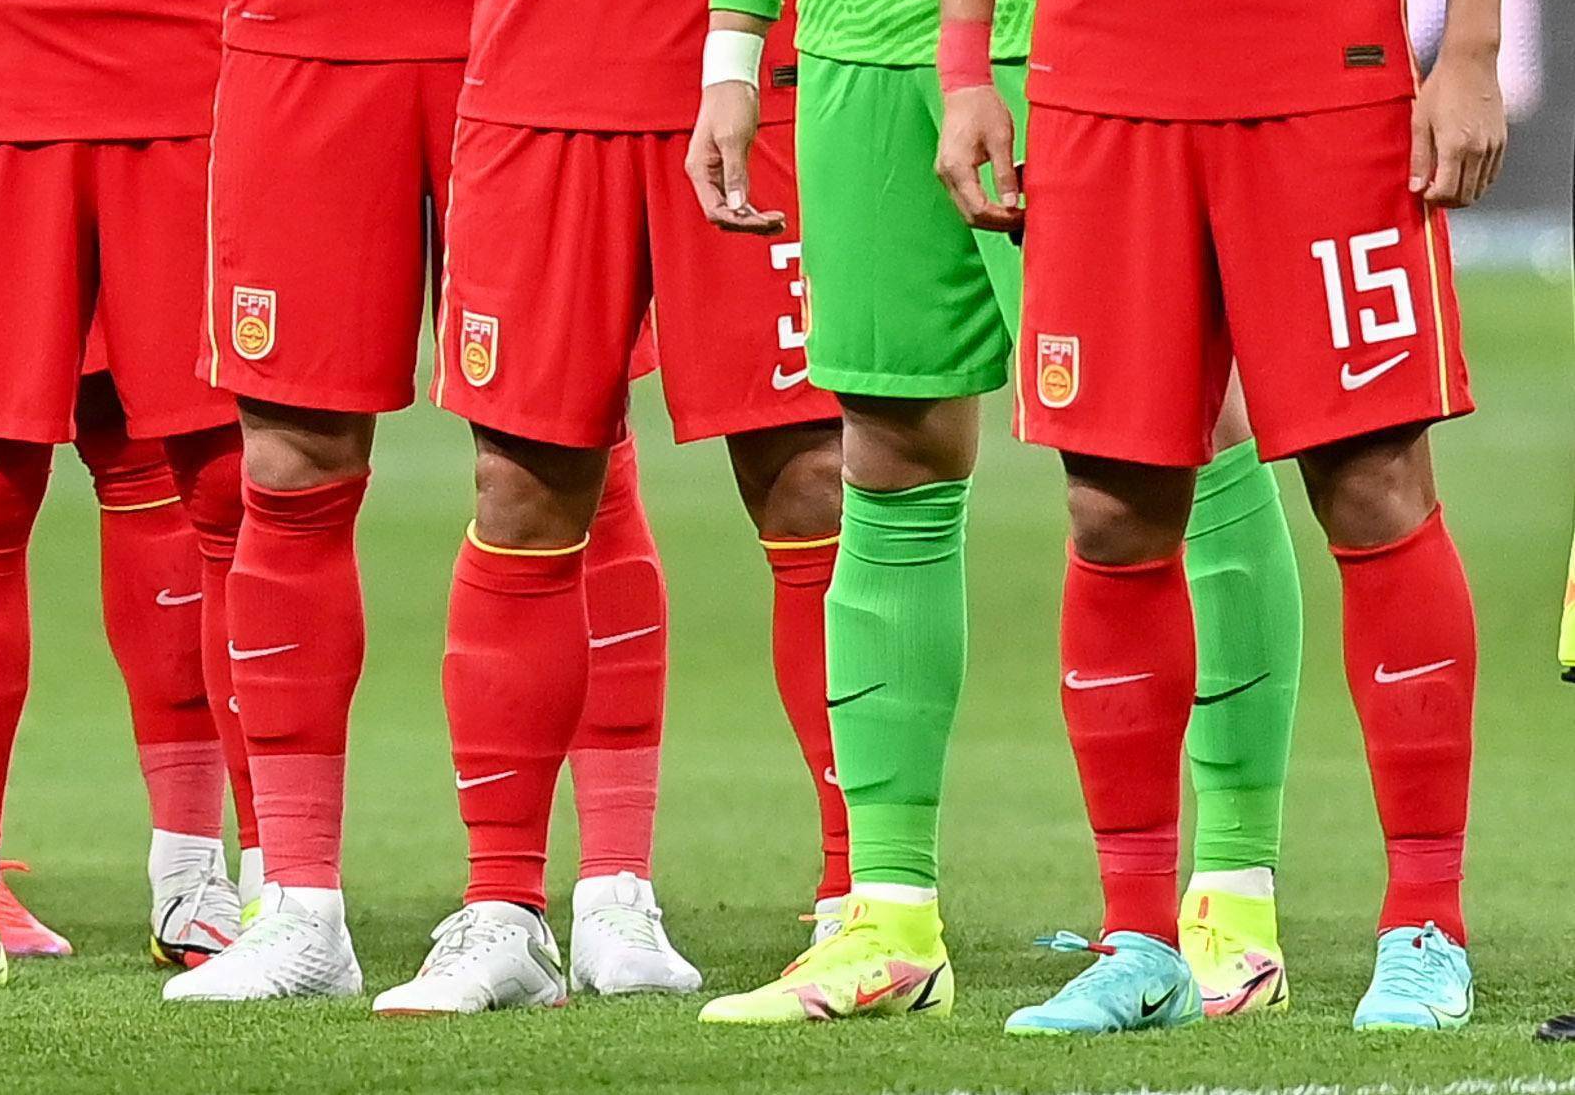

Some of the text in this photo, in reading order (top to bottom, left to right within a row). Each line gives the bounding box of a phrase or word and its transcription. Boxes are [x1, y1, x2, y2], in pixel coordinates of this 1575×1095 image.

[1311, 227, 1417, 349] 15
[237, 293, 270, 309] CFA
[463, 319, 492, 336] CFA
[1040, 342, 1073, 357] CFA
